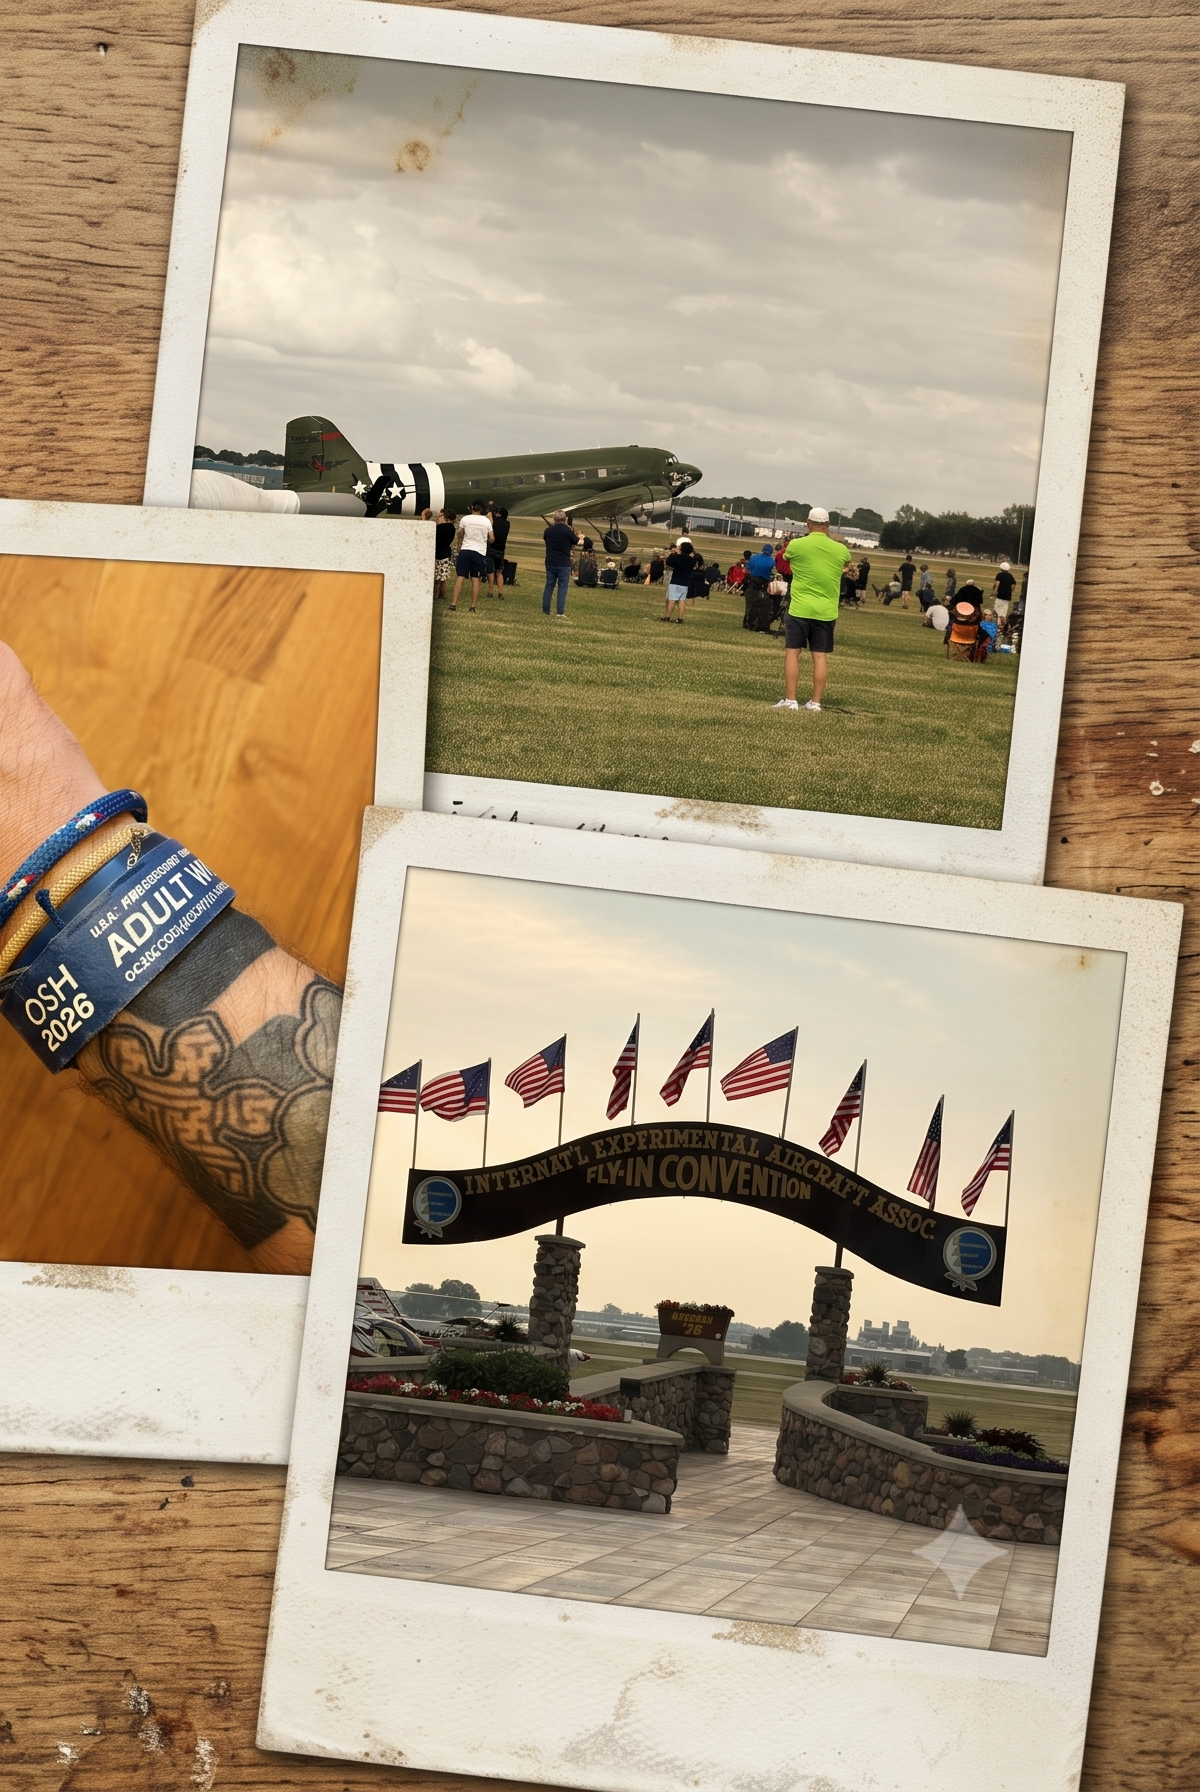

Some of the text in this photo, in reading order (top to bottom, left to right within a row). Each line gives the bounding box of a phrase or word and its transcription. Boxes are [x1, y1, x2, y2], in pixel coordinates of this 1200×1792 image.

[107, 872, 194, 968] ADULT
[25, 963, 79, 1026] OSH
[42, 993, 95, 1052] 2026
[464, 1128, 937, 1240] INTERNAT'L EXPERIMENTAL AIRCRAFT ASSOC.
[586, 1154, 812, 1200] FLY-IN CONVENTION
